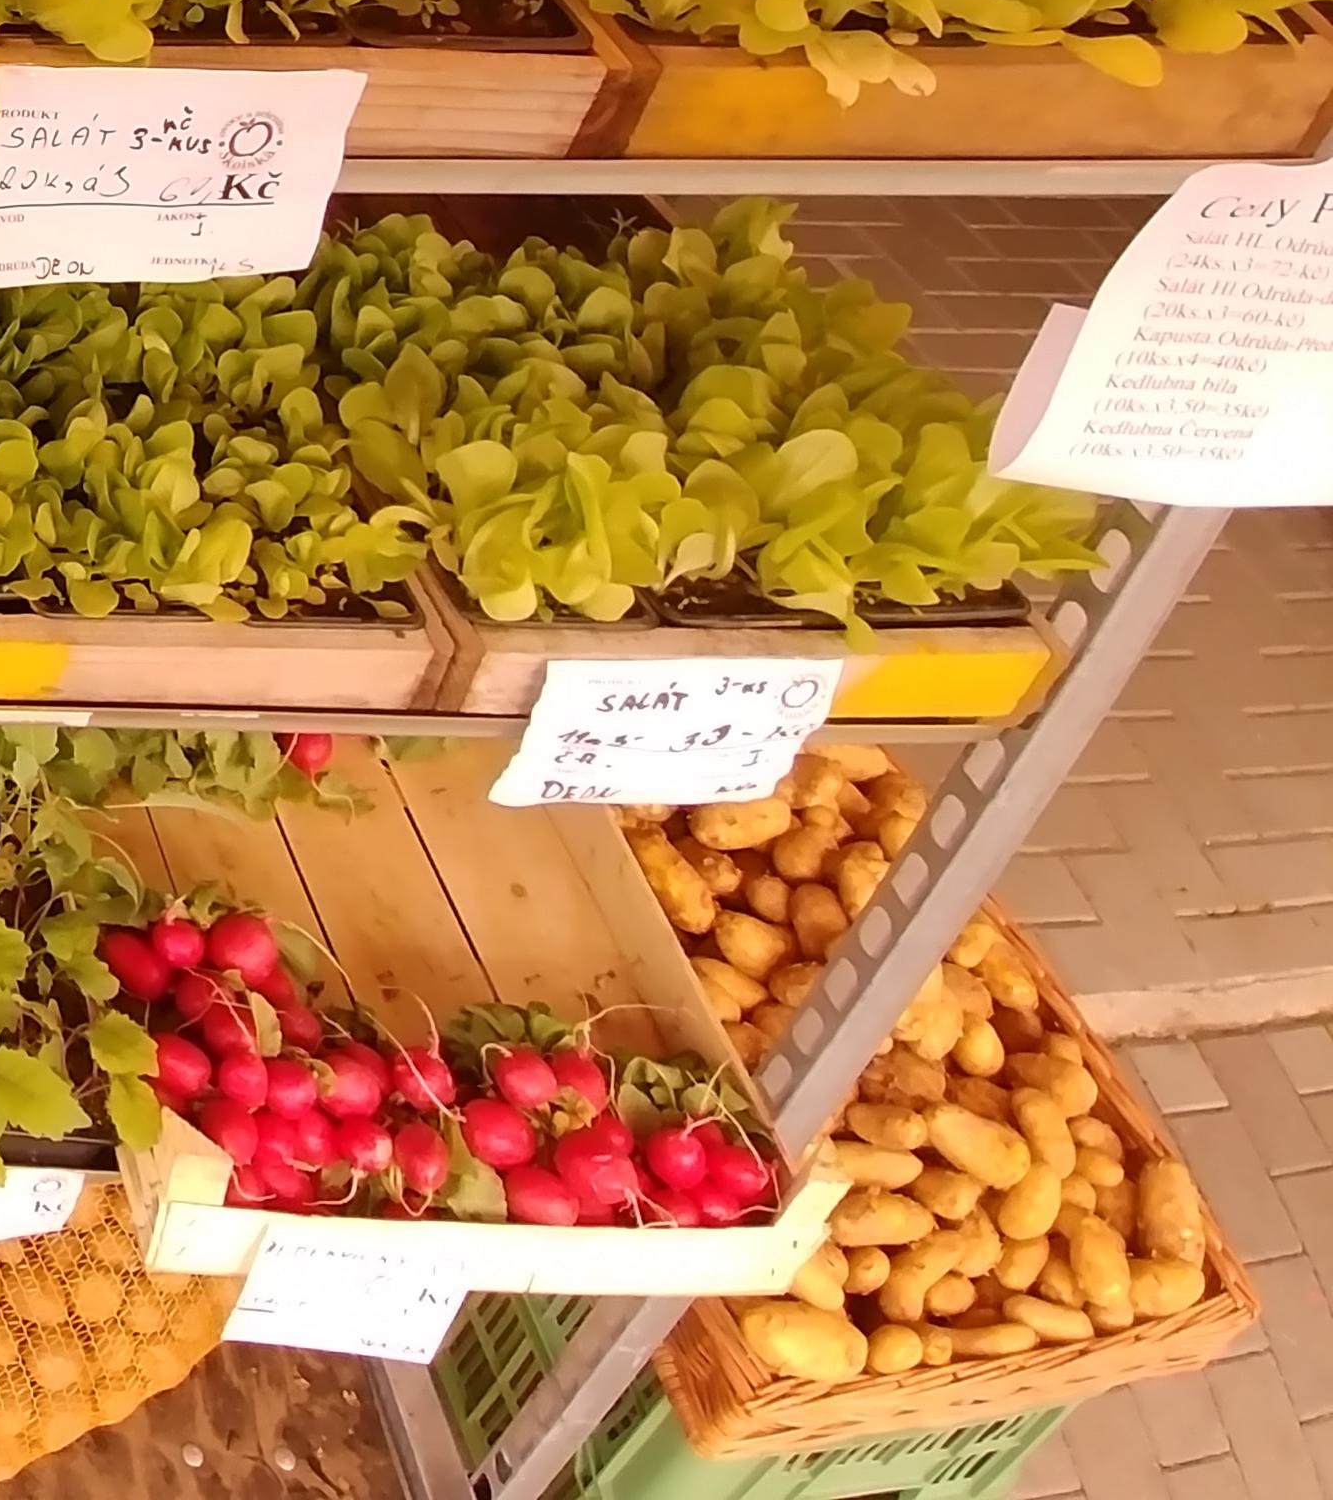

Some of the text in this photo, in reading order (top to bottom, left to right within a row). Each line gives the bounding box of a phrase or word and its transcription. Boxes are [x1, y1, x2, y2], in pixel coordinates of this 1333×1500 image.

[1, 113, 117, 149] SALÁT
[217, 171, 283, 200] Kč
[1156, 278, 1204, 295] Salát
[1242, 282, 1333, 306] Odrůda-d
[1105, 373, 1196, 392] Kedlubna
[1083, 419, 1173, 437] Kedlubna
[595, 681, 689, 712] SALÁT
